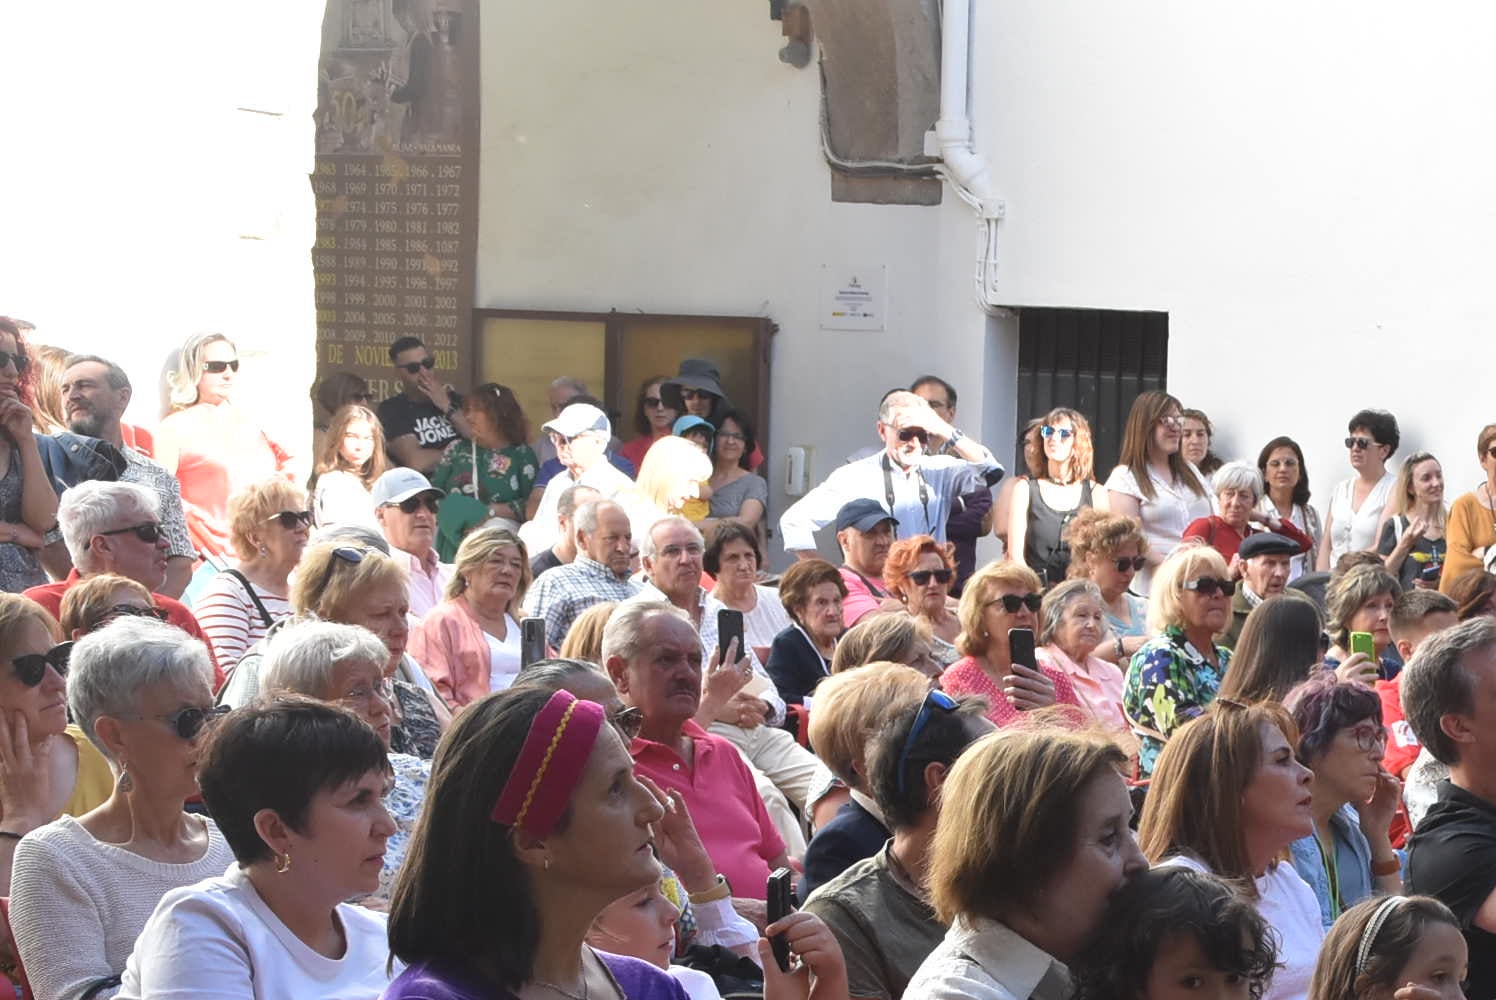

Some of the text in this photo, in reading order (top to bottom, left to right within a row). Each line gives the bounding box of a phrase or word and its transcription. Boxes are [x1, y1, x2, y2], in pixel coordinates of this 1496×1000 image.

[328, 344, 344, 365] DE
[433, 350, 458, 370] 2013
[418, 425, 457, 446] JONE
